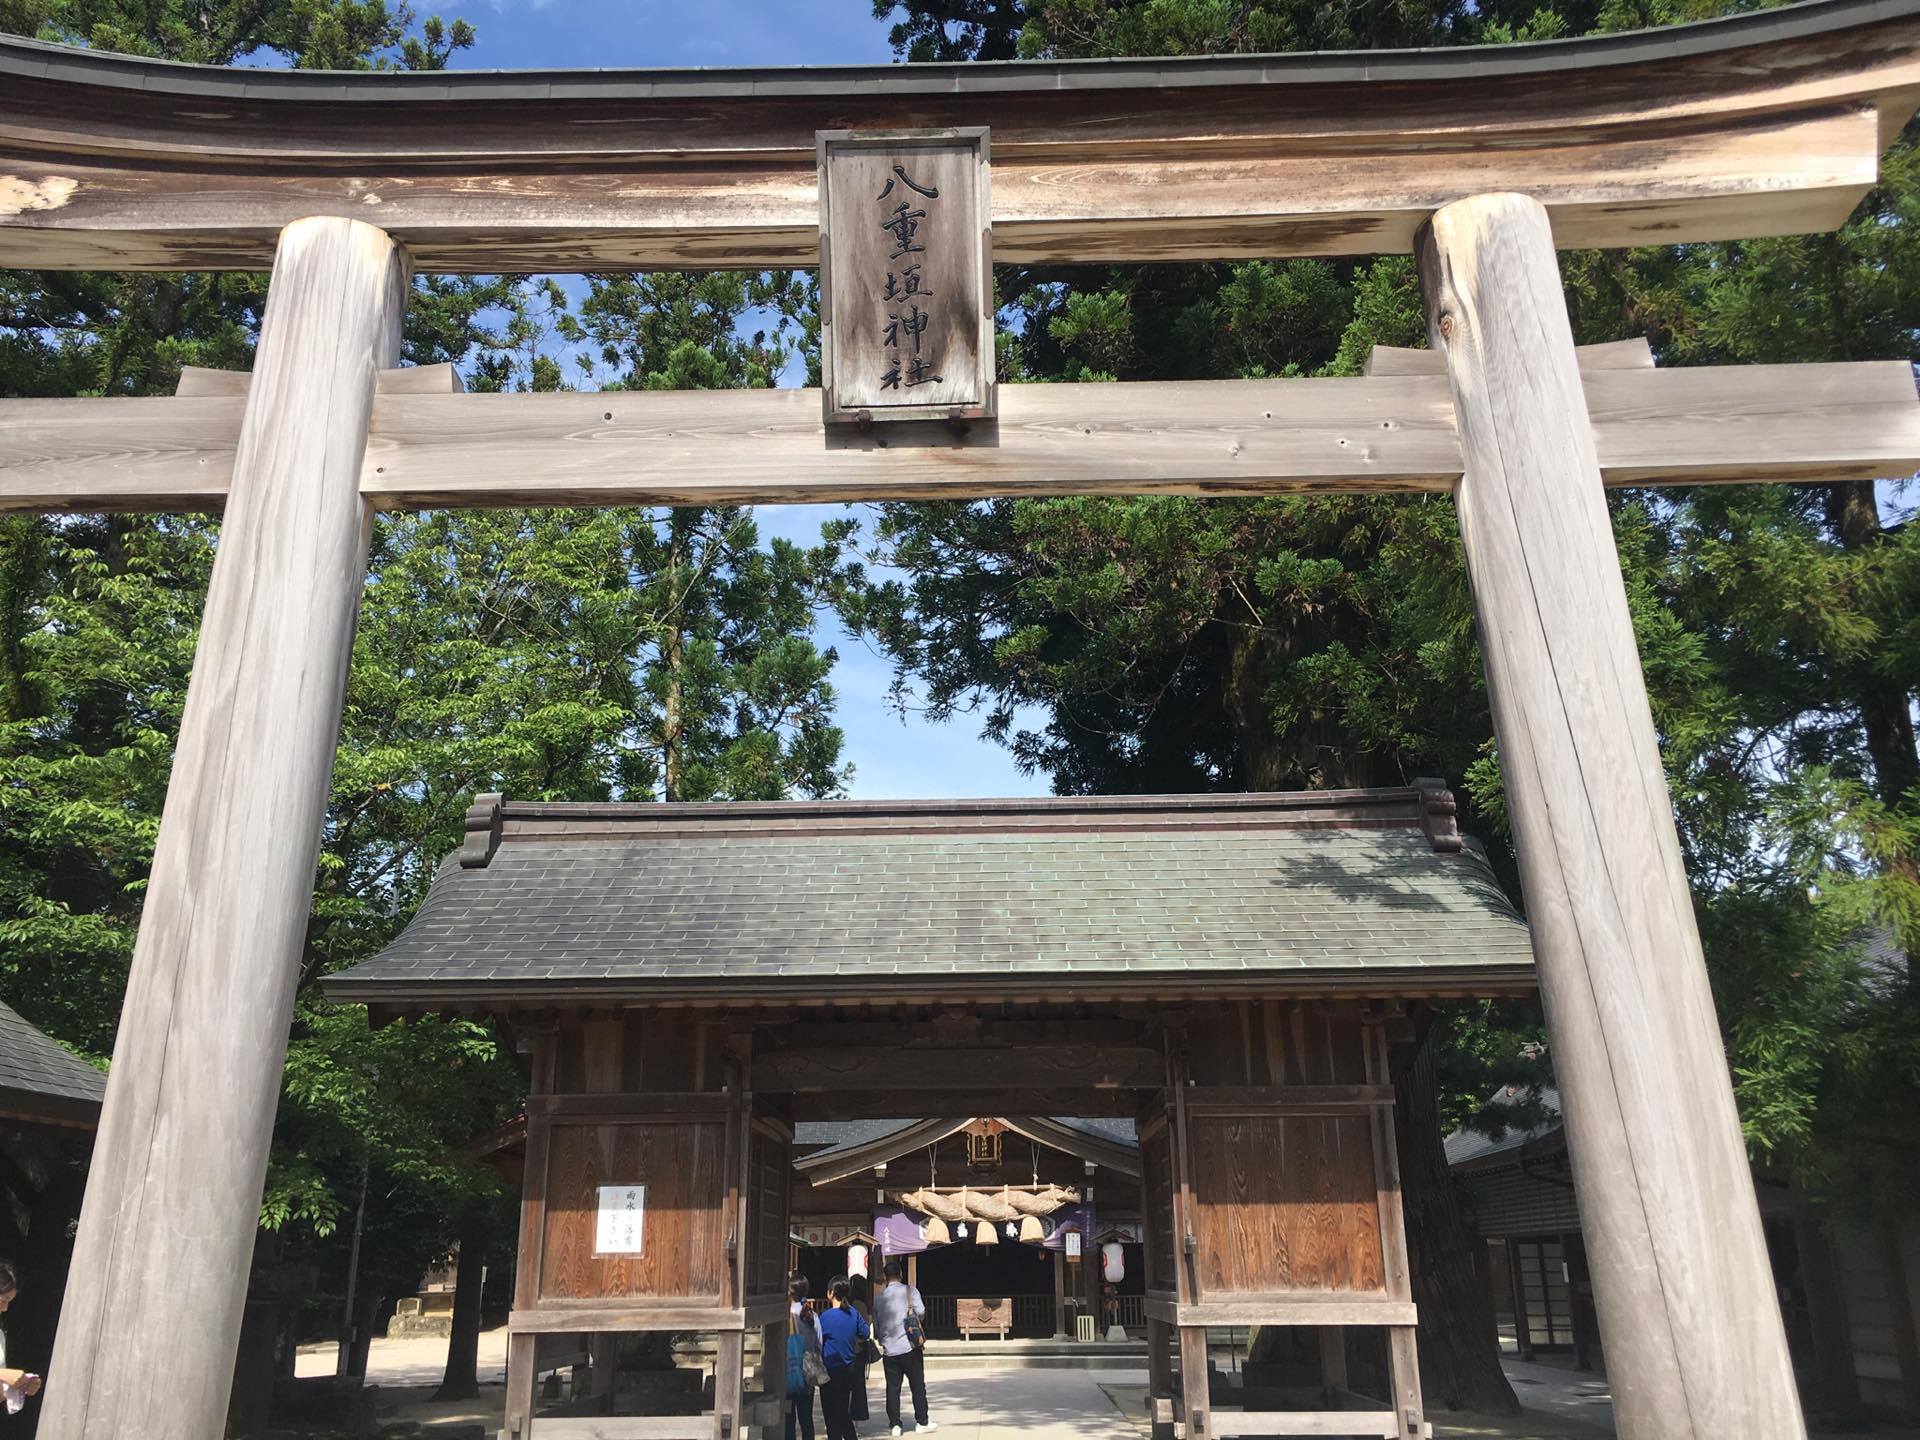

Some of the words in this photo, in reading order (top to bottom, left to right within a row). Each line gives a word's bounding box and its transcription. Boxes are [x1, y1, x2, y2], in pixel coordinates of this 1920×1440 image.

[876, 165, 943, 391] 八重垣神社
